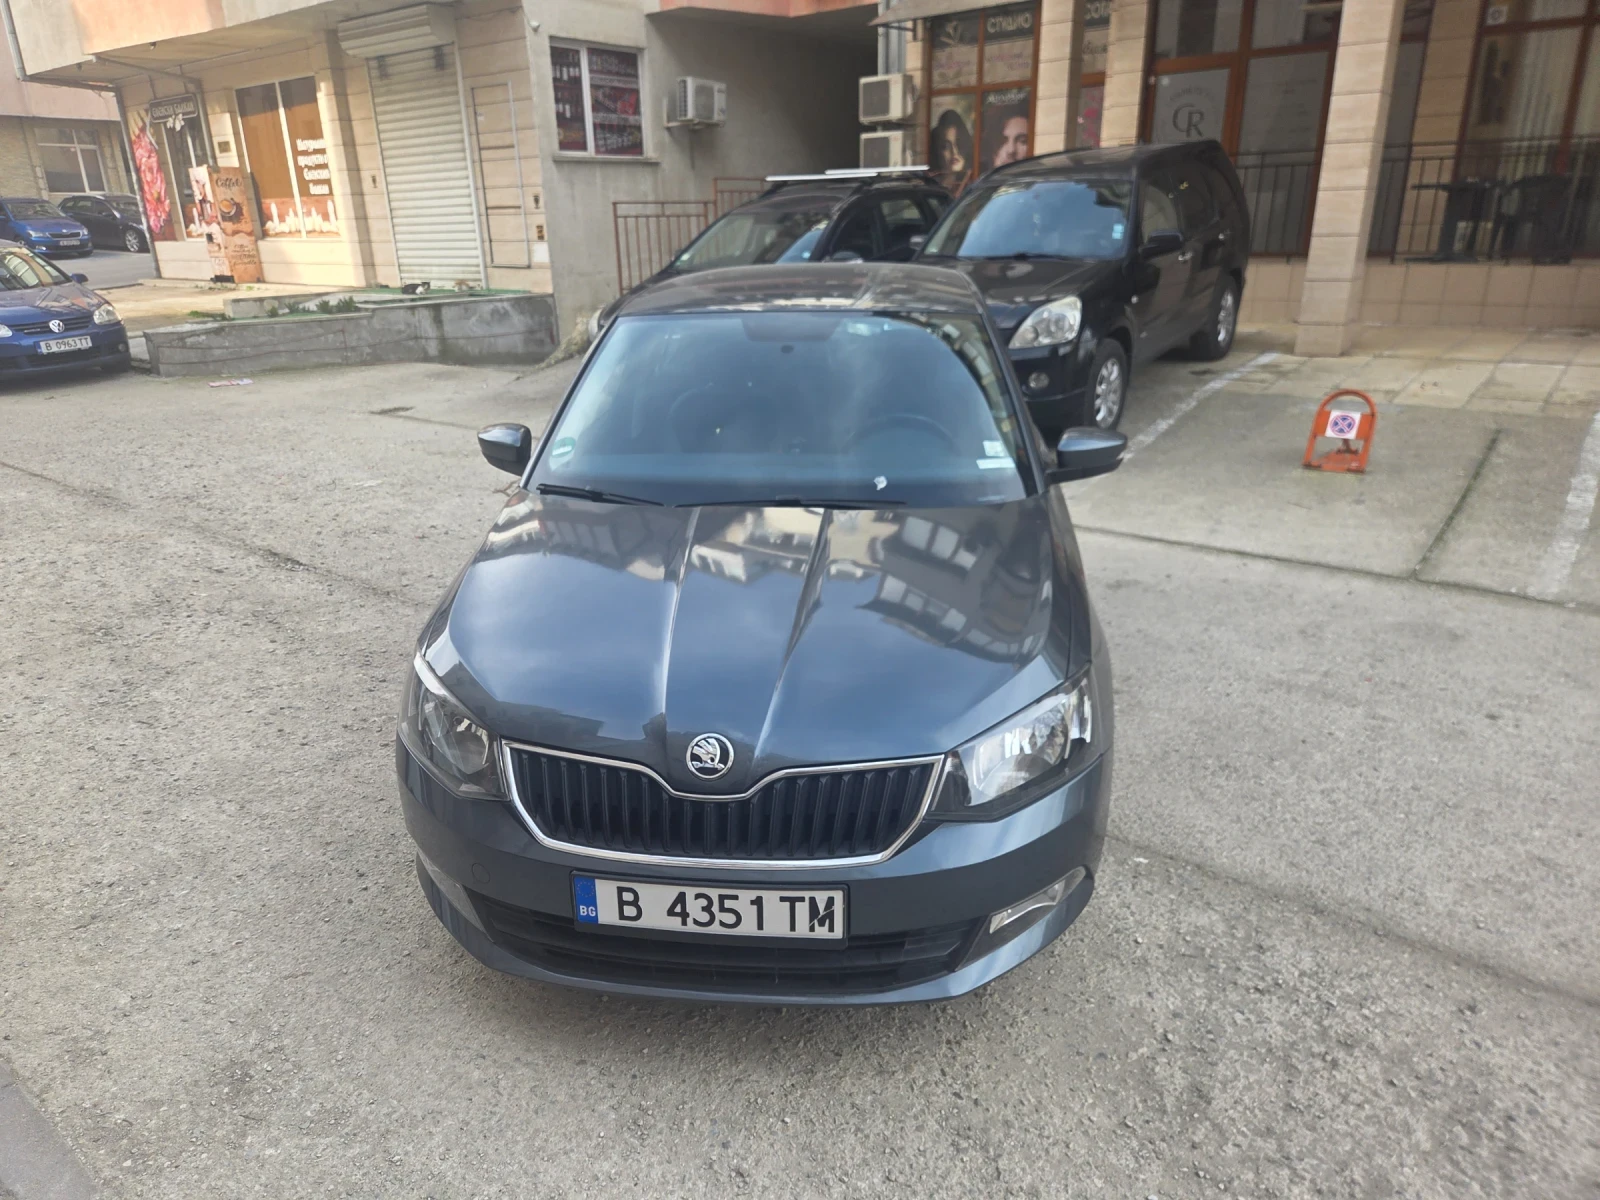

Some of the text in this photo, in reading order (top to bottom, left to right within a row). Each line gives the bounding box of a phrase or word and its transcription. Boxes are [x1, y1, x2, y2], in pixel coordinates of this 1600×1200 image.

[986, 11, 1032, 33] СТУДИО
[44, 342, 52, 351] B
[56, 340, 77, 350] 0963
[79, 338, 90, 347] TT
[579, 905, 596, 917] BG
[616, 886, 836, 933] B 4351 TM
